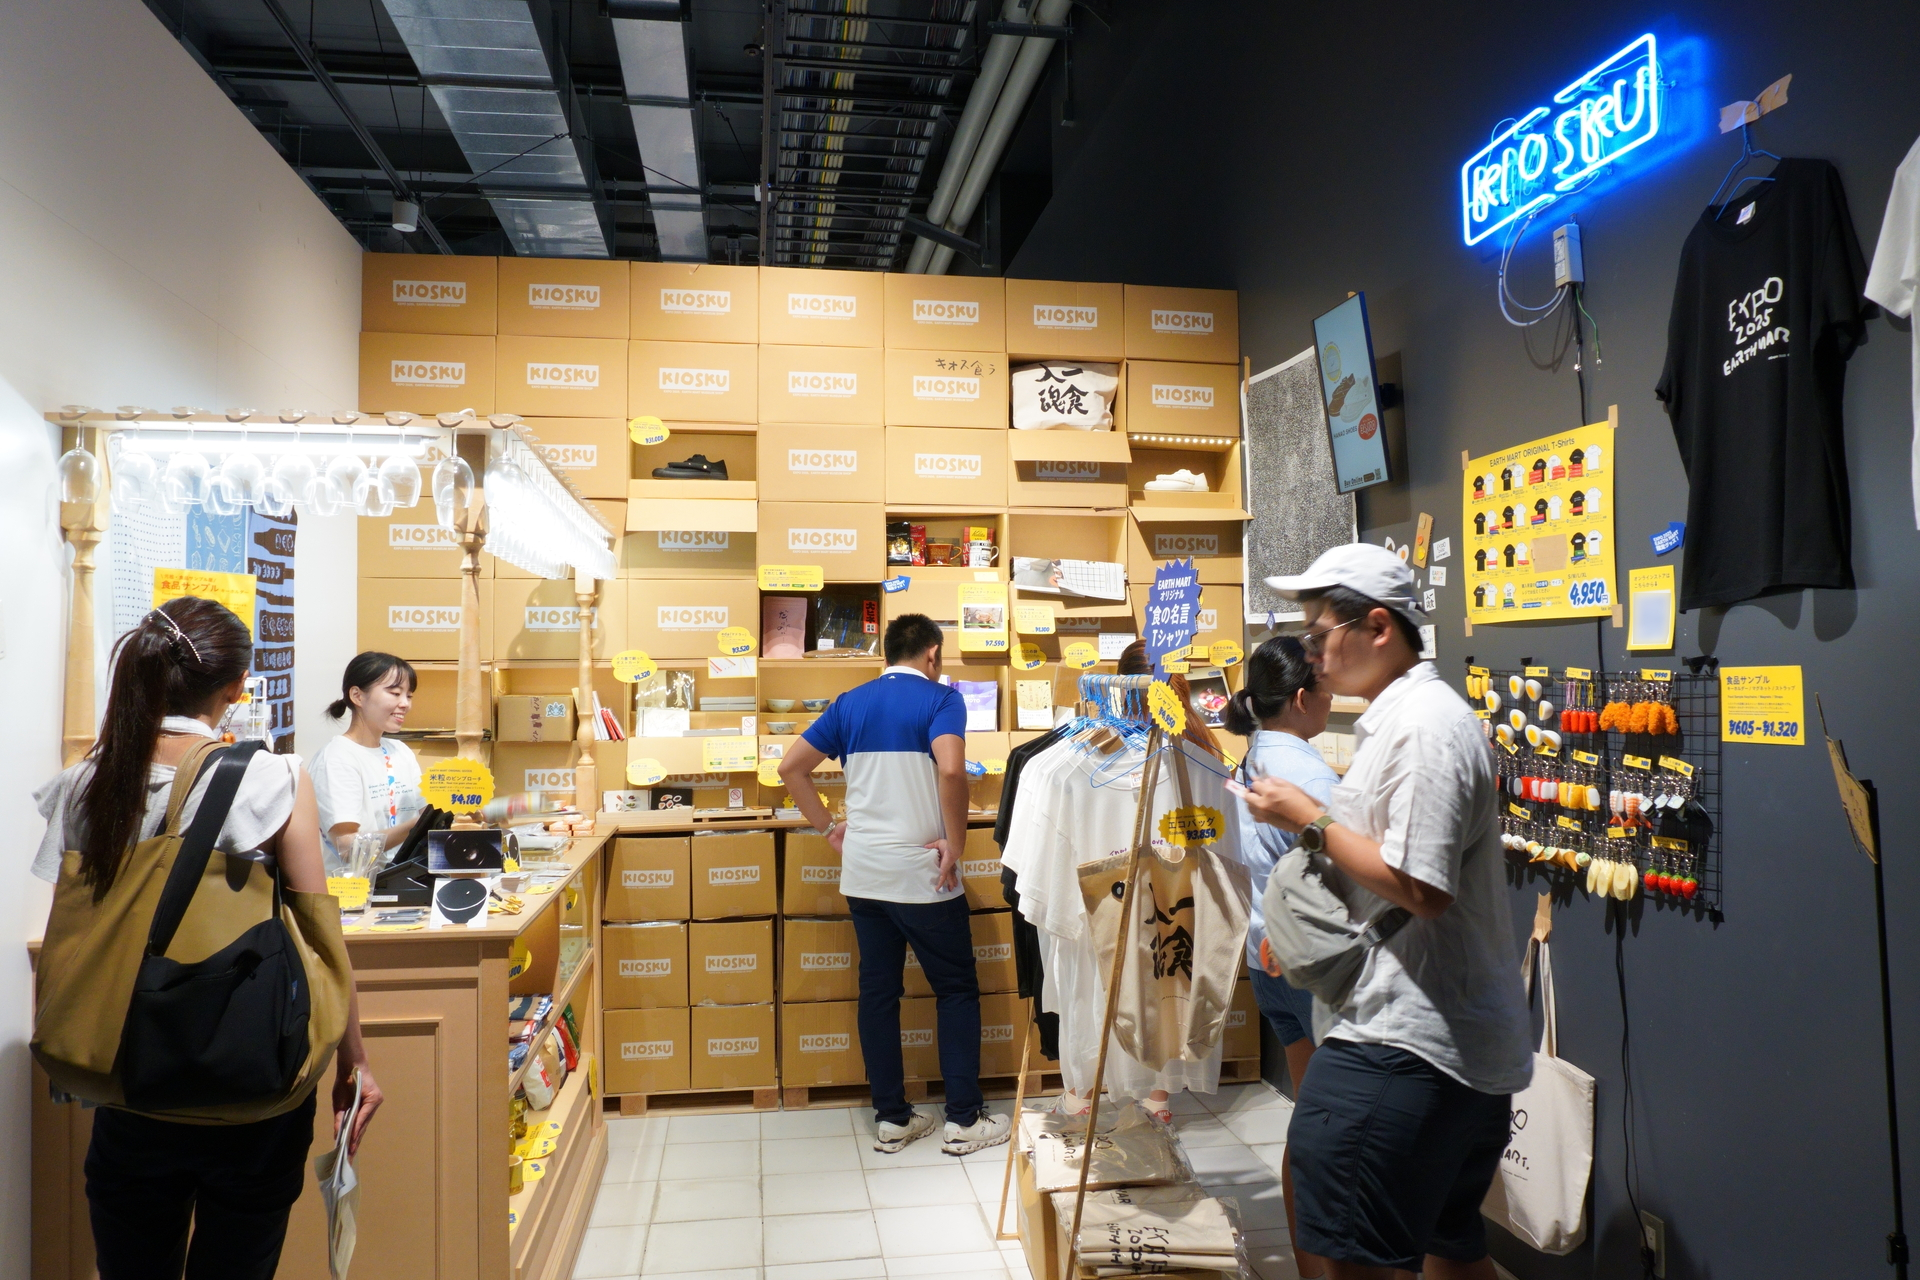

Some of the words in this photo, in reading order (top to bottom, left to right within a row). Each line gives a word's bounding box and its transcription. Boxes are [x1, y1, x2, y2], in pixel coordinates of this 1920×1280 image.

[1472, 65, 1650, 222] KIOSKU
[396, 284, 464, 300] KIOSKU
[532, 288, 598, 304] KIOSKU
[663, 292, 728, 308] KIOSKU
[791, 297, 854, 314] KIOSKU
[916, 303, 977, 319] KIOSKU
[1728, 276, 1784, 331] EXPO
[1036, 309, 1096, 324] KIOSKU
[1154, 313, 1212, 329] KIOSKU
[1735, 307, 1774, 345] 2025
[1723, 341, 1758, 376] EARTH
[394, 364, 463, 380] KIOSKU
[530, 367, 597, 382] KIOSKU
[662, 371, 727, 387] KIOSKU
[791, 375, 855, 391] KIOSKU
[916, 379, 978, 395] KIOSKU
[1154, 387, 1213, 403] KIOSKU
[1489, 453, 1506, 467] EARTH
[1506, 450, 1522, 463] MART
[1523, 444, 1550, 457] ORIGINAL
[1551, 437, 1575, 449] T-Shirts
[791, 453, 855, 469] KIOSKU
[917, 457, 980, 473] KIOSKU
[791, 532, 855, 548] KIOSKU
[1157, 536, 1217, 552] KIOSKU
[161, 580, 219, 592] 食品サンプル
[1157, 578, 1175, 591] EARTH
[1175, 575, 1192, 589] MART
[1160, 588, 1185, 602] オリジナル
[392, 609, 460, 626] KIOSKU
[660, 609, 727, 625] KIOSKU
[1726, 675, 1770, 686] 食品サンプル
[1168, 816, 1215, 829] エコバッグ
[624, 872, 672, 884] KIOSKU
[711, 868, 759, 880] KIOSKU
[620, 960, 671, 973] KIOSKU
[706, 956, 755, 969] KIOSKU
[803, 955, 850, 967] KIOSKU
[709, 1040, 758, 1053] KIOSKU
[801, 1035, 849, 1048] KIOSKU
[622, 1043, 672, 1057] KIOSKU
